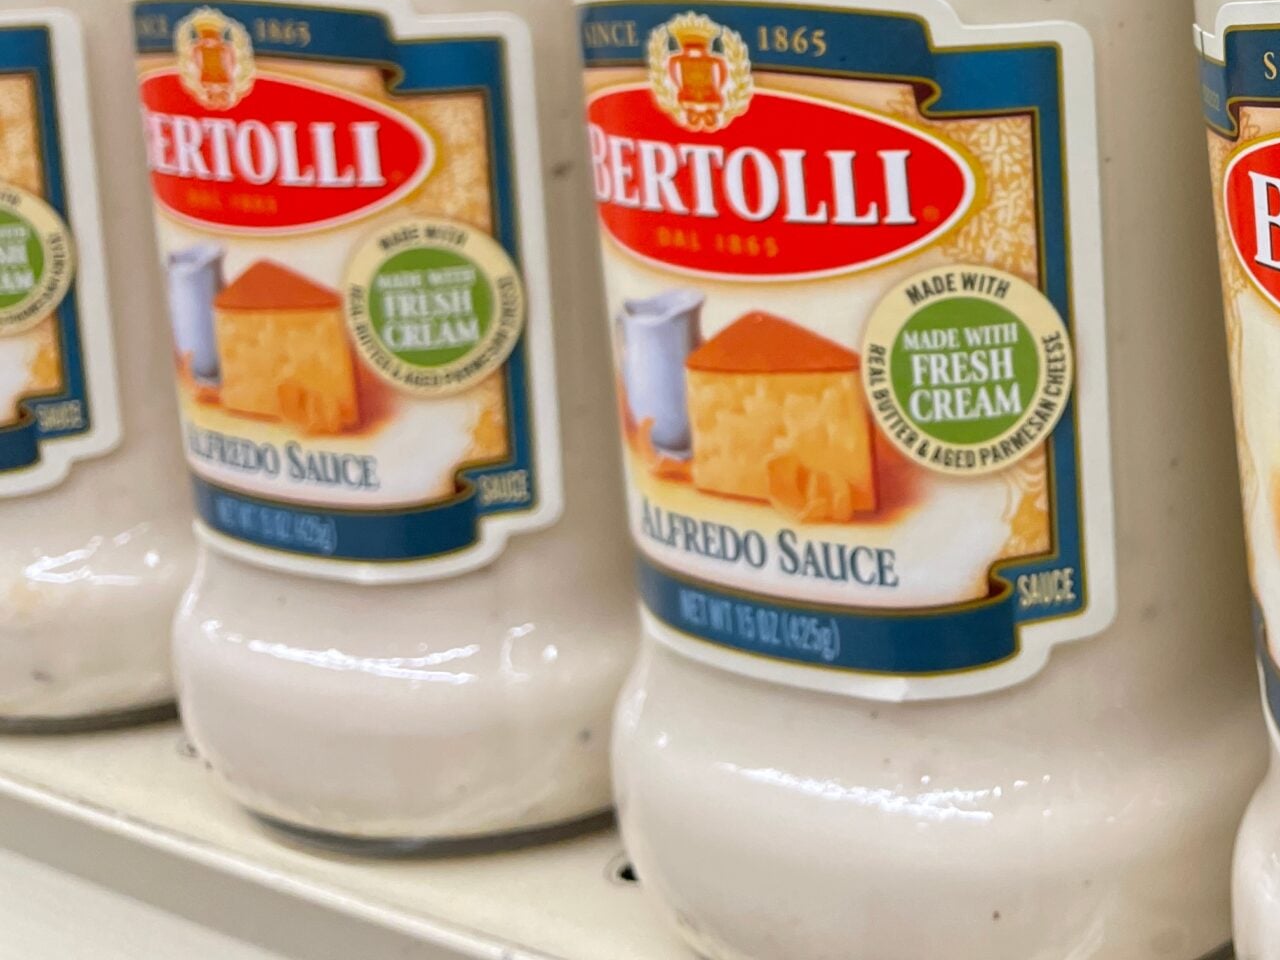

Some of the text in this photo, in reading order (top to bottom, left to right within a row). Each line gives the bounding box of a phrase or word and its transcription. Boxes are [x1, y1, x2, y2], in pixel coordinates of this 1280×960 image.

[757, 25, 827, 56] 1865
[586, 123, 917, 227] BERTOLLI
[905, 271, 1011, 306] MADE WITH
[902, 322, 1019, 351] MADE WITH
[868, 343, 887, 387] REAL
[910, 346, 1015, 387] FRESH
[1041, 331, 1067, 398] CHEESE
[872, 388, 920, 450] BUTTER
[908, 382, 1023, 423] CREAM
[979, 398, 1057, 467] PARMESAN
[287, 440, 381, 491] SAUCE
[931, 448, 976, 469] AGED
[641, 498, 900, 588] ALFREDO SAUCE
[1017, 567, 1077, 608] SAUCE
